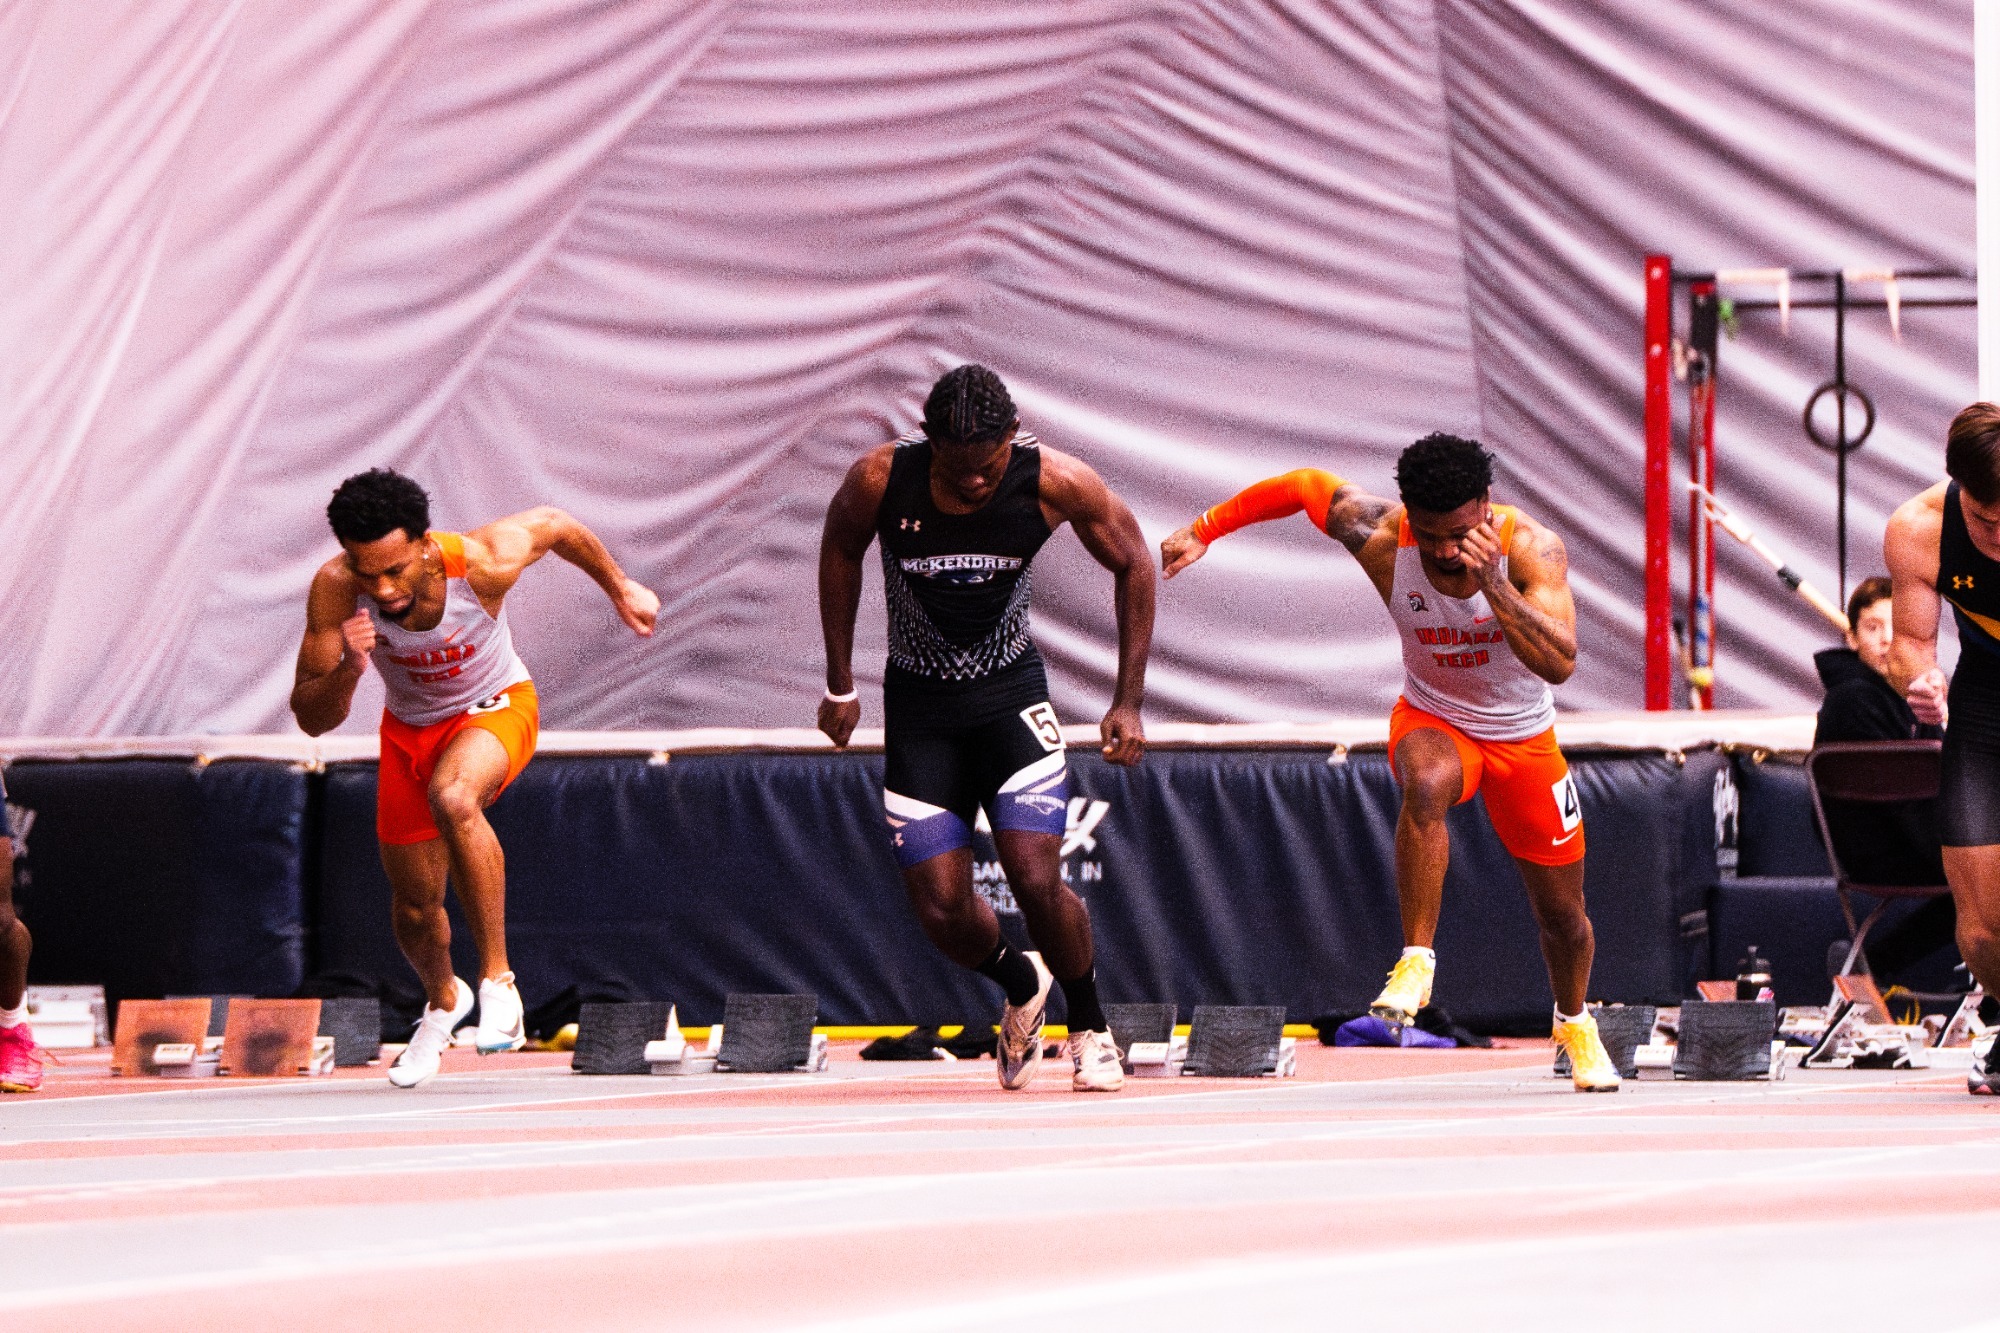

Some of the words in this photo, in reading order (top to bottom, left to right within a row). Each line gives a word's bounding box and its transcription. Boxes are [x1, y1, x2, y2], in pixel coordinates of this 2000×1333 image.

[1415, 627, 1504, 646] INDIANA
[1433, 649, 1490, 668] TECH
[1029, 707, 1061, 744] 5
[1564, 779, 1579, 819] 4
